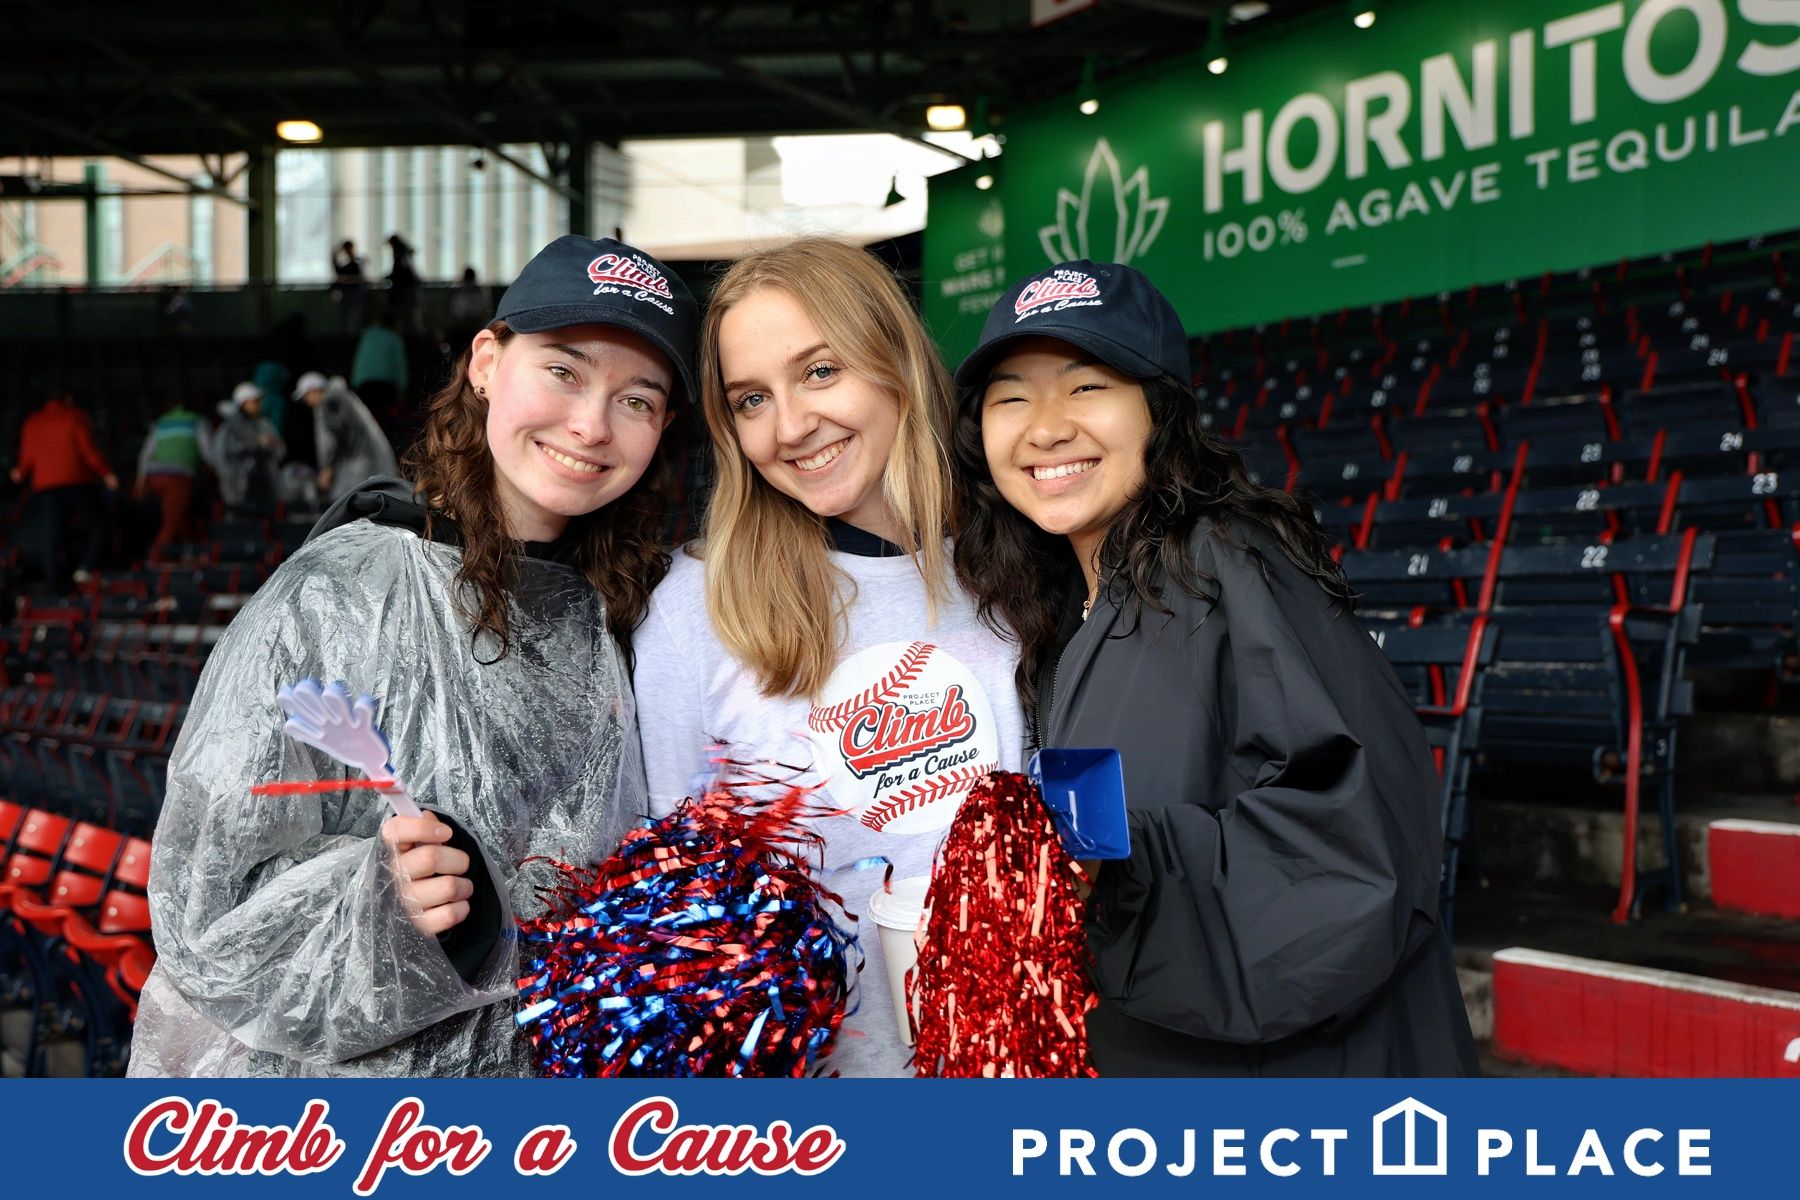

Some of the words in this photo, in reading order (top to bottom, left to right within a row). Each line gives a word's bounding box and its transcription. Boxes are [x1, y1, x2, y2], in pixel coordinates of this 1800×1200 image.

[1203, 207, 1308, 261] 100%
[1325, 162, 1500, 236] AGAVE
[1525, 89, 1800, 189] TEQUILA
[587, 253, 673, 299] Climb
[593, 282, 620, 296] for
[621, 288, 633, 297] a
[634, 290, 674, 315] Cause
[1014, 277, 1100, 315] Climb
[1040, 304, 1053, 313] a
[1054, 299, 1103, 311] Cause
[1751, 472, 1779, 495] 23
[1575, 489, 1601, 511] 22
[1407, 553, 1430, 576] 21
[1580, 545, 1609, 568] 22
[902, 691, 940, 700] PROJECT
[839, 684, 977, 768] Climb
[873, 772, 905, 799] for
[908, 766, 921, 781] a
[924, 747, 980, 775] Cause
